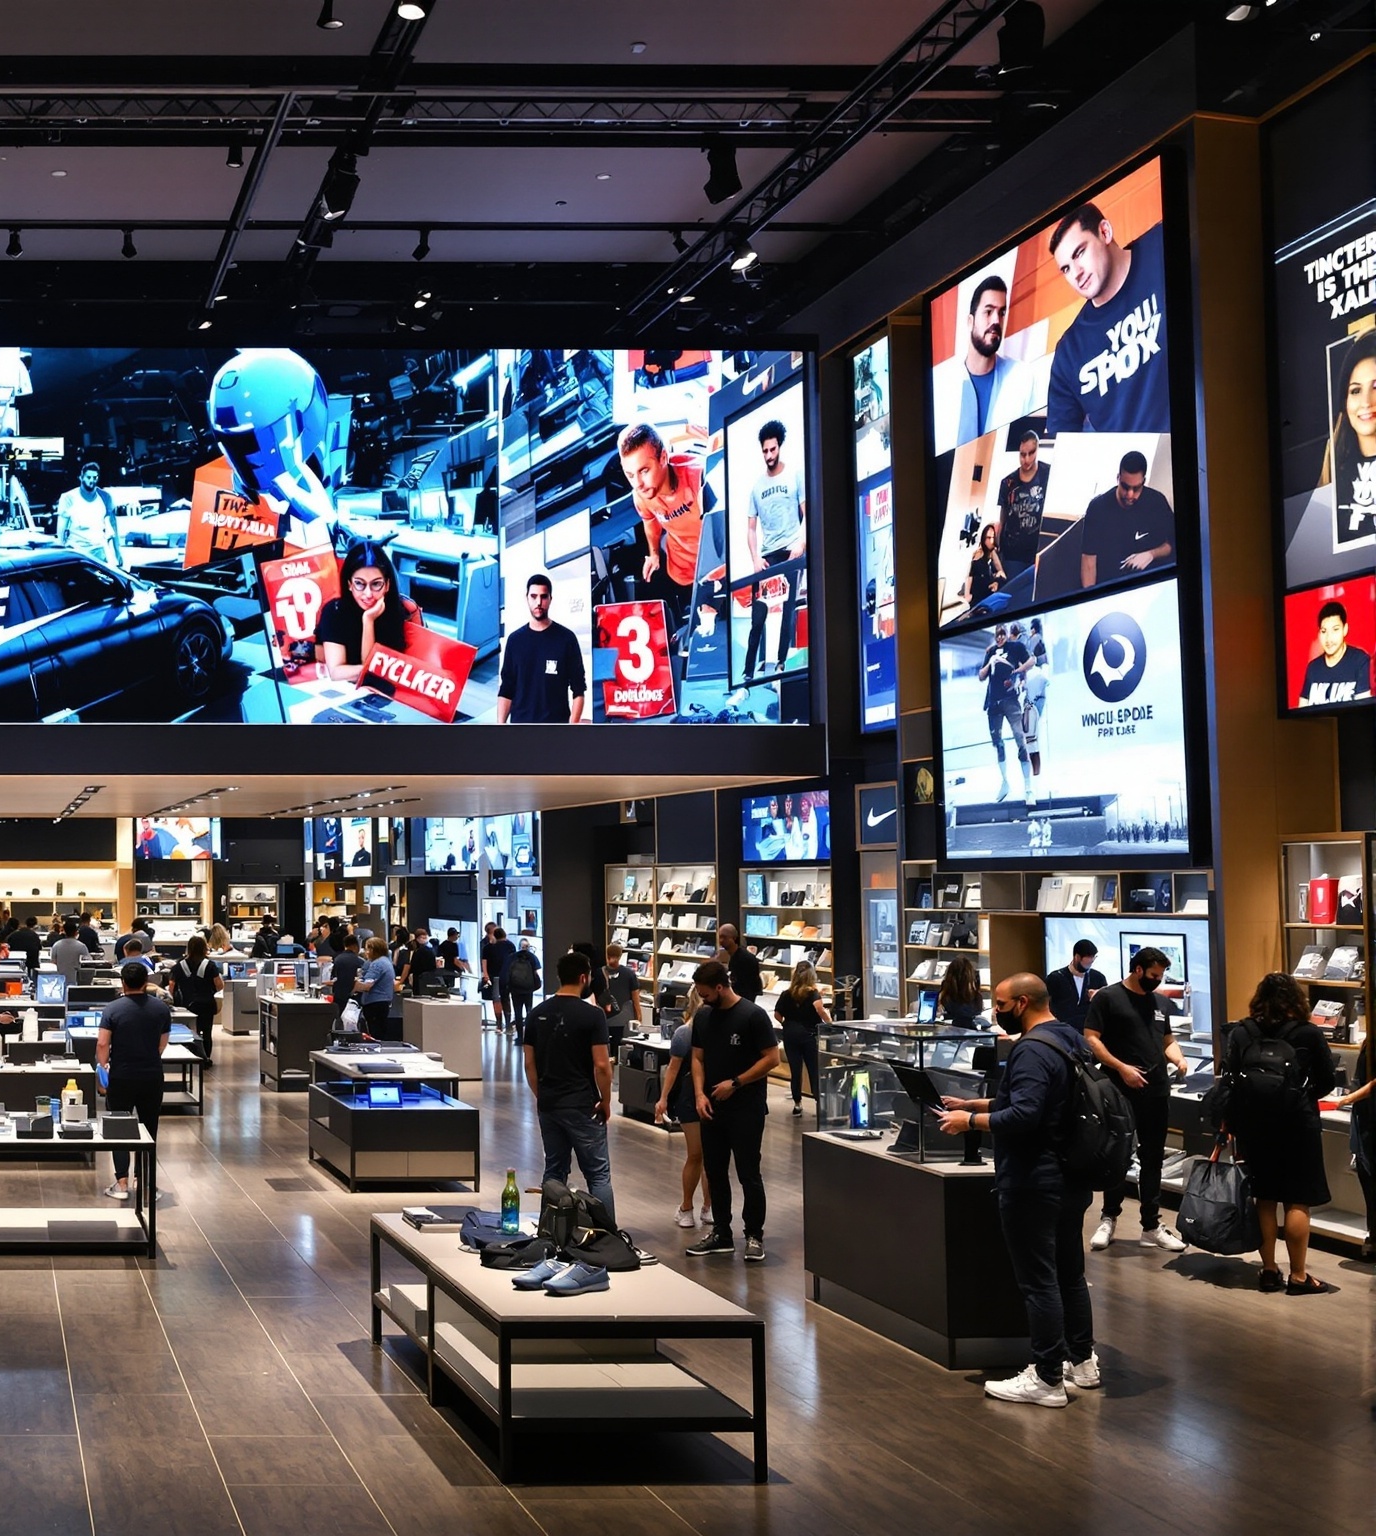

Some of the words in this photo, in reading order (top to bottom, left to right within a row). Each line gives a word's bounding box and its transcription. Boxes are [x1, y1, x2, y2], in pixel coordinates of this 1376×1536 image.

[1317, 276, 1336, 303] IS
[616, 615, 655, 684] 3
[368, 651, 456, 704] FYCLKER
